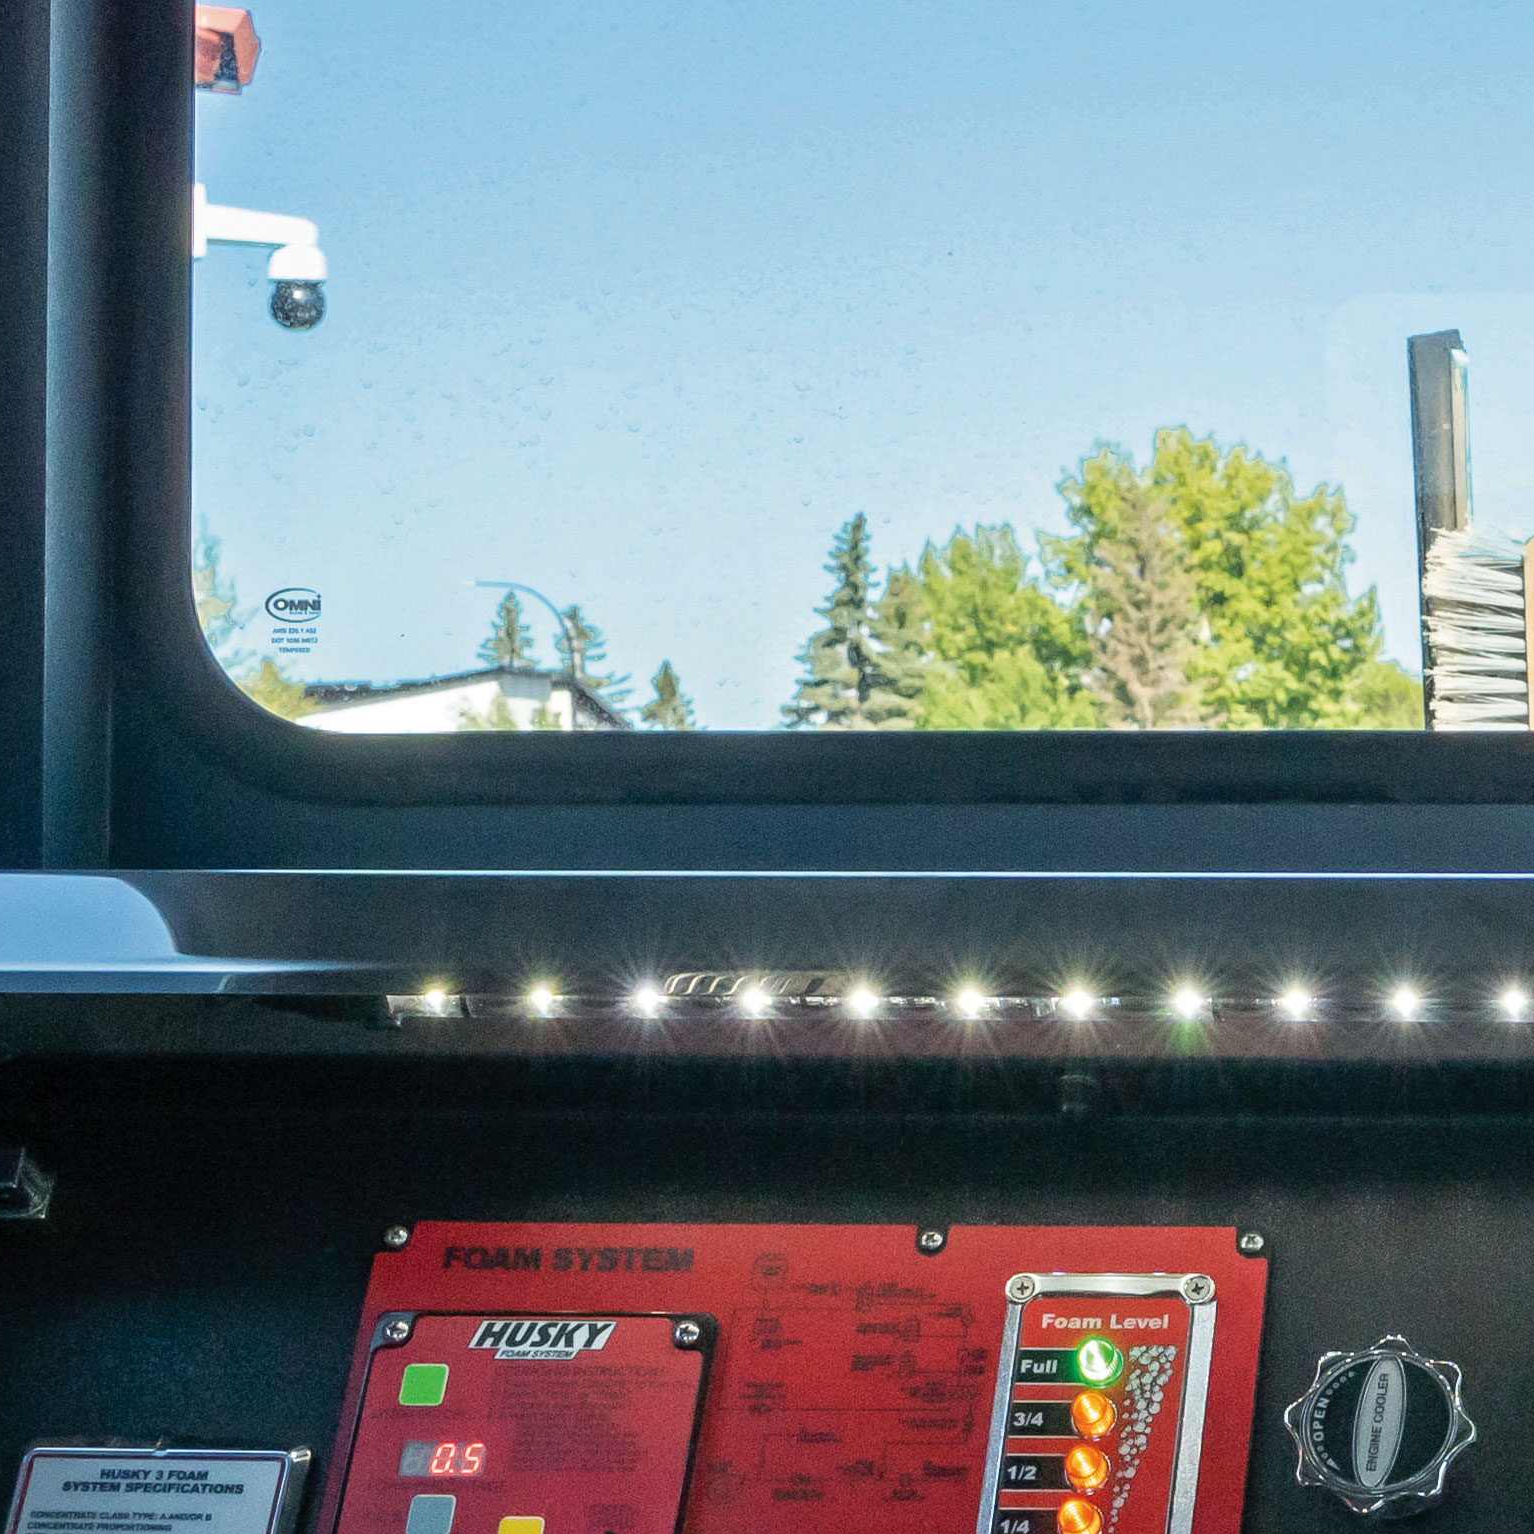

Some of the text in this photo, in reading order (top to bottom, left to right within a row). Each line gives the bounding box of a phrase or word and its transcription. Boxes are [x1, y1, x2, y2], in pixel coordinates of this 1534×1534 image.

[443, 1247, 694, 1272] FOAM SYSTEM
[1041, 1313, 1169, 1330] Foam Level
[474, 1321, 612, 1349] HUSKY
[499, 1350, 575, 1359] FOAM SYSTEM
[1020, 1359, 1058, 1374] Full
[1013, 1412, 1044, 1426] 3/4
[1312, 1397, 1330, 1442] OPEN
[1366, 1372, 1390, 1472] ENGINE COOLER
[430, 1443, 484, 1474] 0.5
[100, 1469, 209, 1481] HUSKY 3 FOAM
[1007, 1466, 1037, 1480] 1/2
[63, 1481, 244, 1494] SYSTEM SPECIFICATIONS
[1000, 1520, 1030, 1534] 1/4
